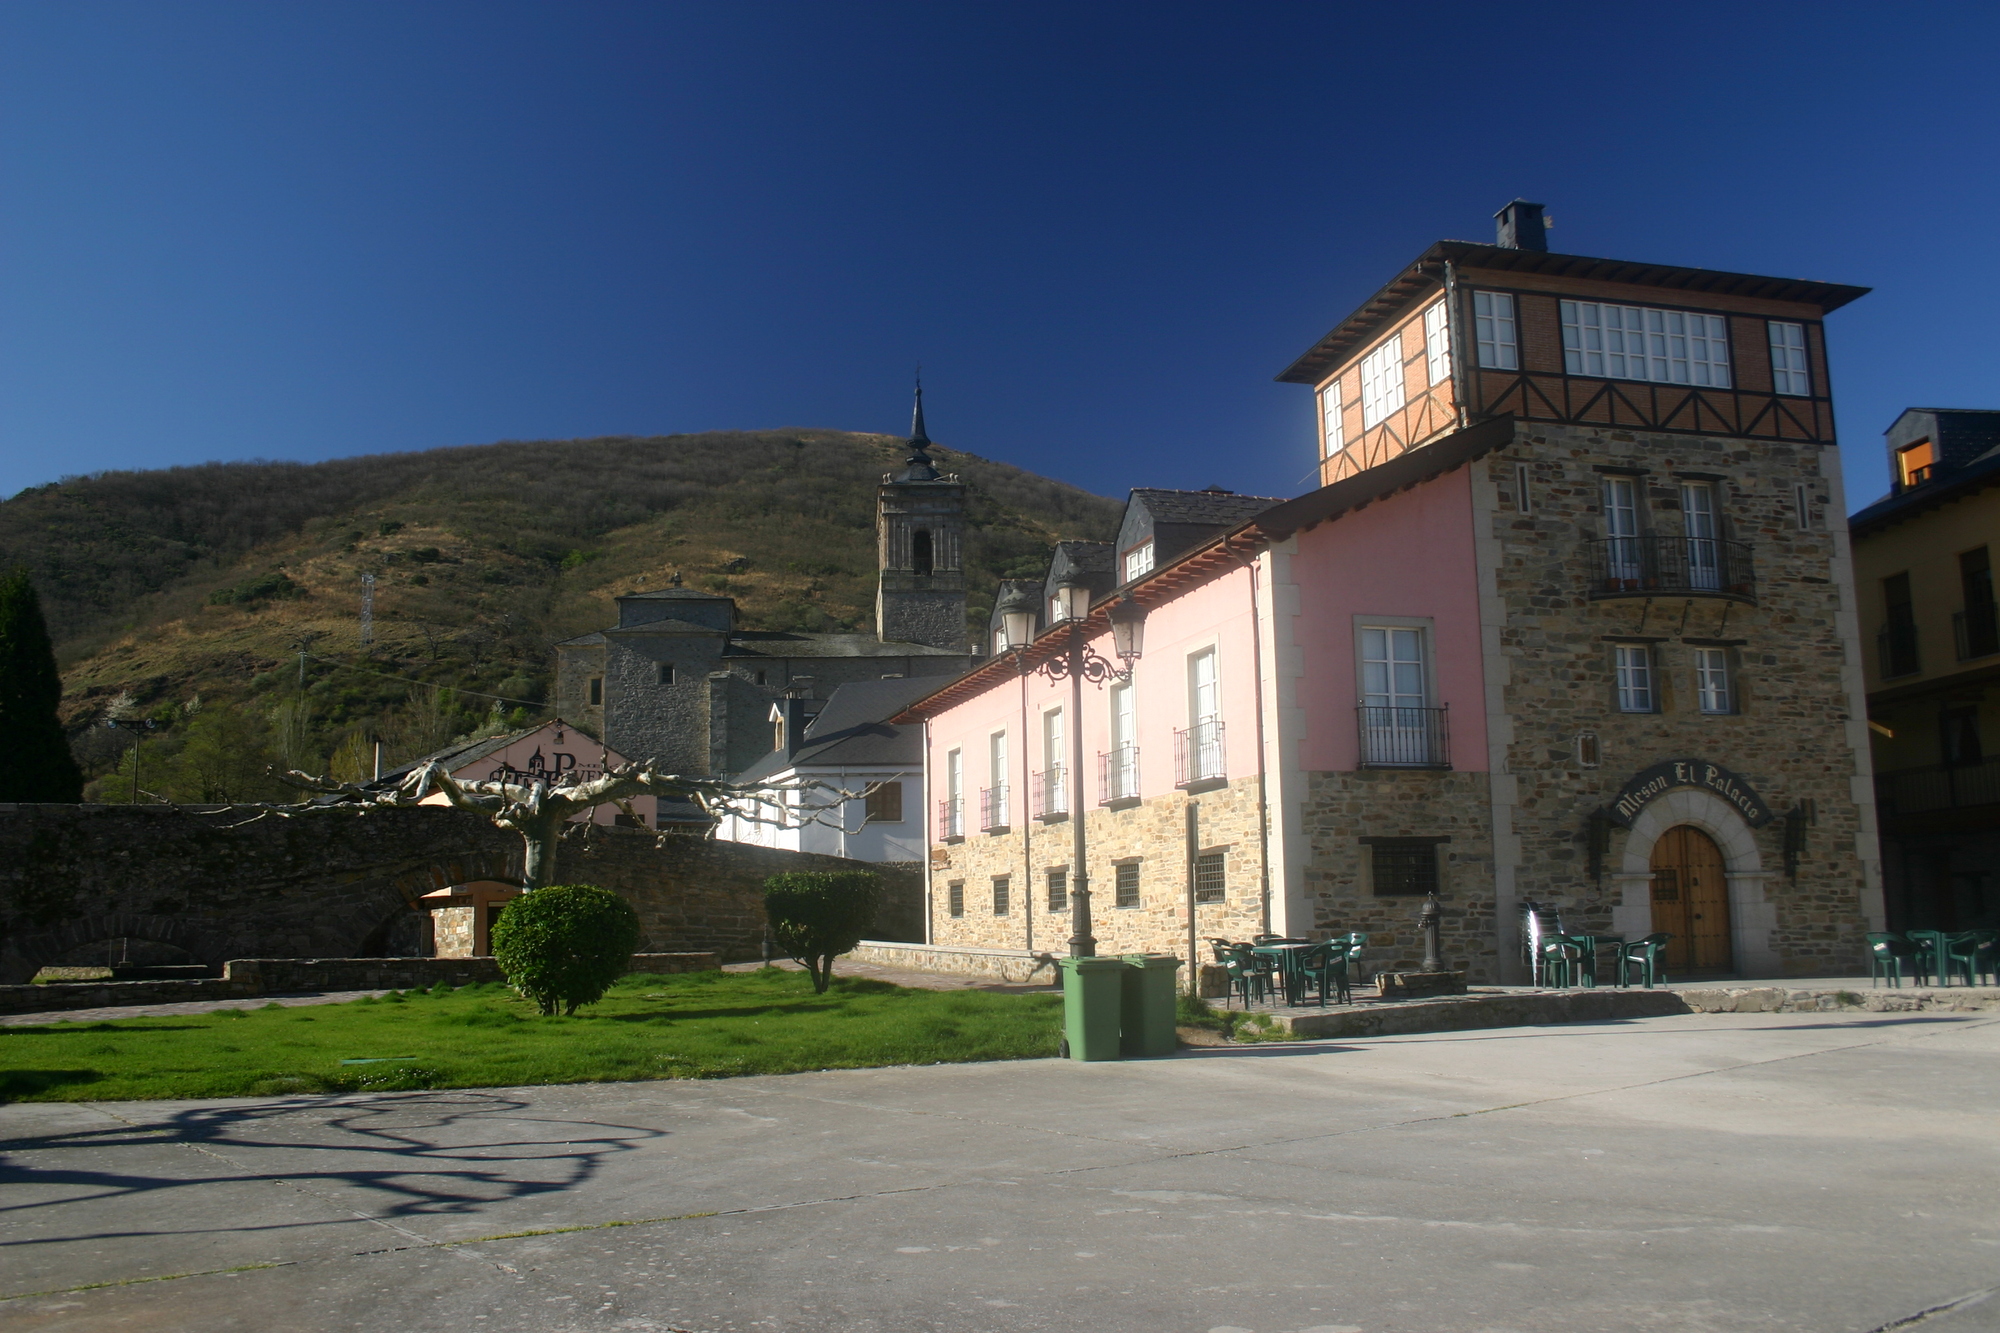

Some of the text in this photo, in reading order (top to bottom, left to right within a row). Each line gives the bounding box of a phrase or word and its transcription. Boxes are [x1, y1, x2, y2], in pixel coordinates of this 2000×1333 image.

[1615, 762, 1760, 821] Meson El Palacio
